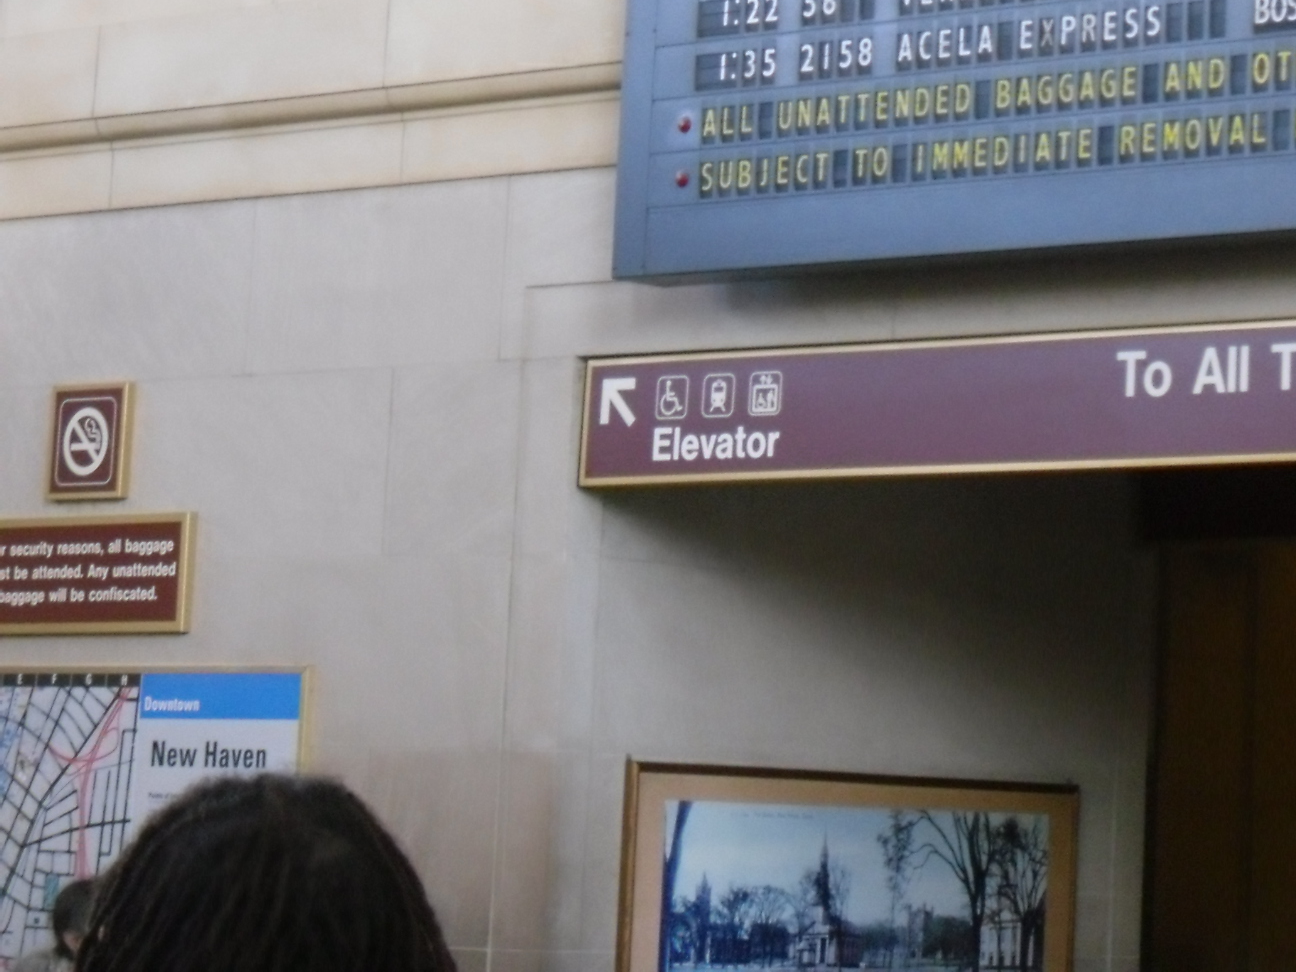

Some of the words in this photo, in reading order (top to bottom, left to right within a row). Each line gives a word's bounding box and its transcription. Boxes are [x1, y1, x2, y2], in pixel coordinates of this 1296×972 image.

[719, 48, 777, 81] 1:35
[801, 38, 873, 73] 2158
[898, 24, 993, 63] ACELA
[1020, 6, 1161, 51] EXPRESS
[703, 105, 753, 138] ALL
[778, 82, 971, 129] UNATTENDED
[996, 66, 1136, 109] BAGGAGE
[1165, 59, 1225, 92] AND
[701, 152, 829, 191] SUBJECT
[855, 146, 889, 178] TO
[916, 128, 1092, 173] IMMEDIATE
[1120, 114, 1266, 154] REMOVAL
[1117, 349, 1172, 398] To
[1193, 346, 1249, 395] All
[651, 426, 780, 462] Elevator
[10, 541, 53, 558] security
[57, 541, 104, 556] reasons,
[108, 539, 121, 554] all
[125, 538, 174, 555] baggage
[14, 565, 28, 579] be
[32, 564, 83, 579] attended.
[87, 563, 109, 580] Any
[112, 561, 177, 577] unattended
[49, 587, 67, 602] will
[70, 588, 85, 602] be
[88, 586, 157, 602] confiscated.
[144, 696, 200, 712] Downtown
[151, 740, 197, 768] New
[204, 740, 267, 768] Haven
